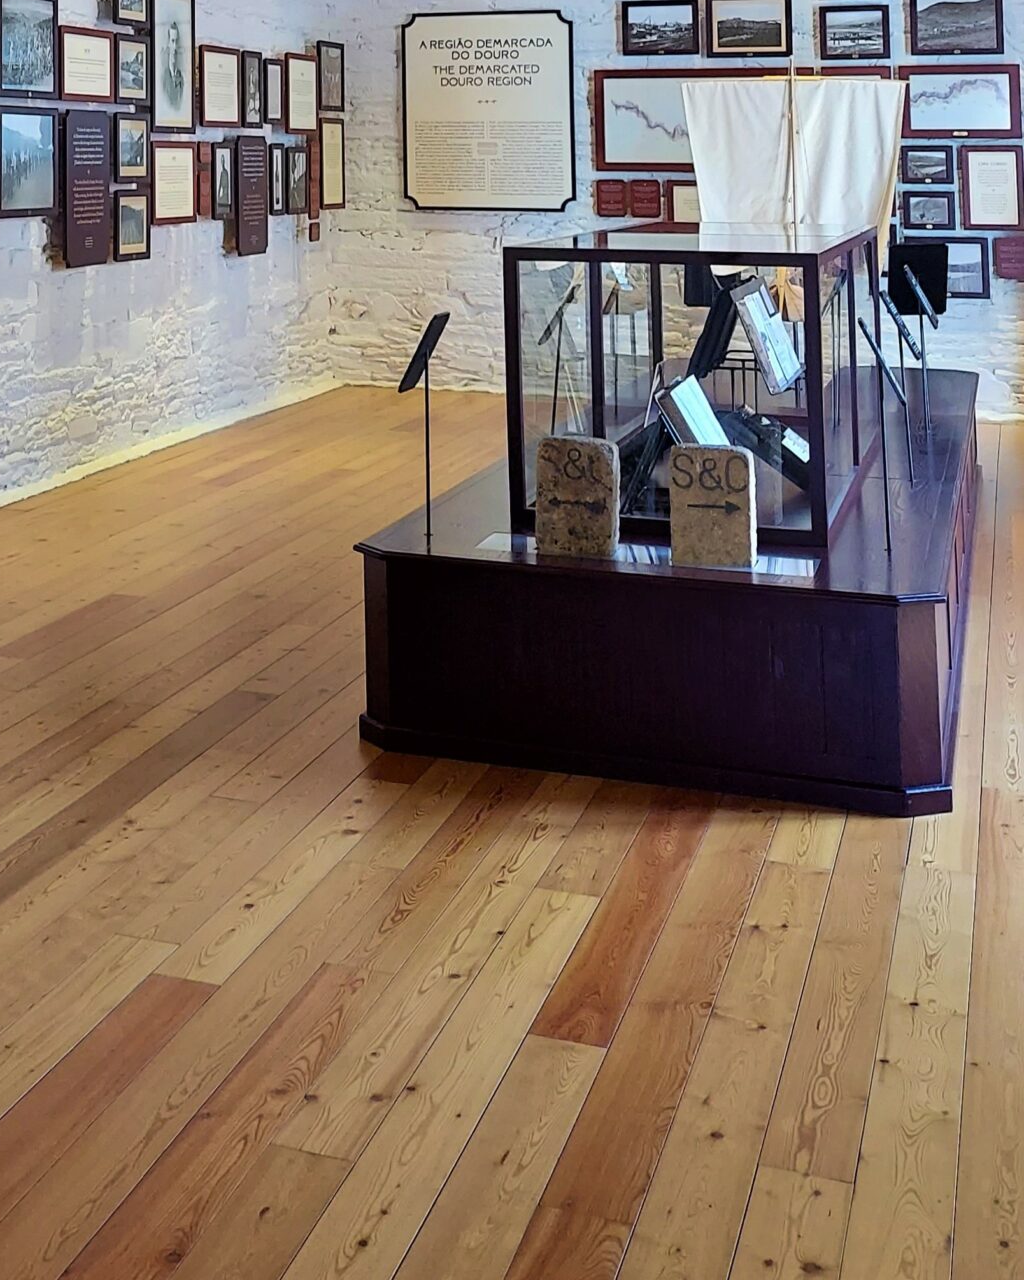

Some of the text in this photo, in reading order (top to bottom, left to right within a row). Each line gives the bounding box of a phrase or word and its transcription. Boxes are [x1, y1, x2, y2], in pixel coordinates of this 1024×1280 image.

[419, 38, 553, 49] A REGIÃO DEMARCADA
[451, 50, 520, 61] DO DOURO
[433, 64, 540, 75] THE DEMARCATED
[441, 76, 532, 87] DOURO REGION
[672, 453, 749, 493] S&C
